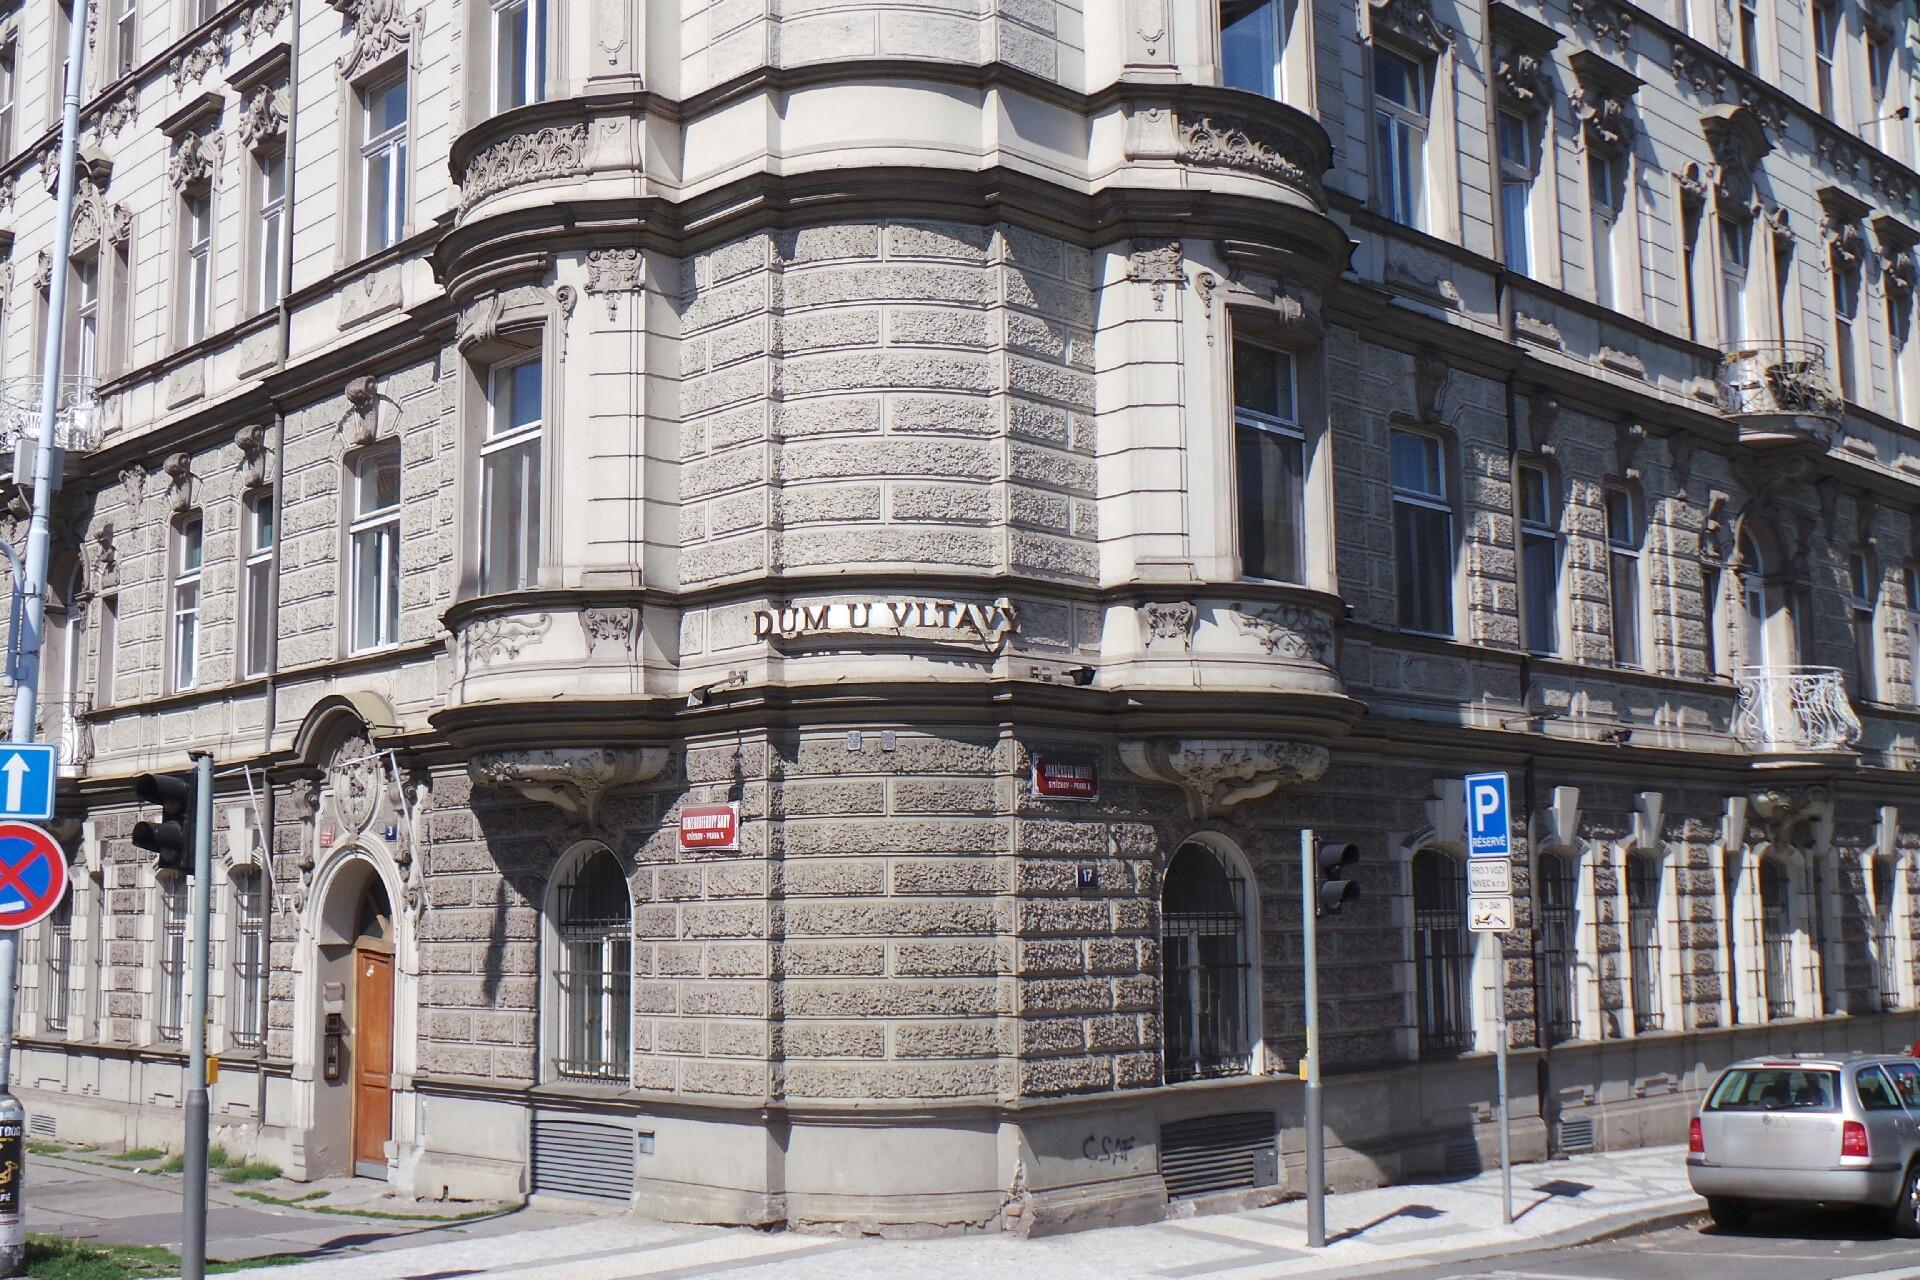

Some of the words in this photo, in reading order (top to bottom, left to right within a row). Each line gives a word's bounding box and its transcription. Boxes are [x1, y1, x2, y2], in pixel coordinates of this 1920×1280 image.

[847, 603, 872, 629] U
[887, 601, 1019, 633] VLTAVY
[1474, 785, 1499, 832] P
[387, 826, 393, 837] 3
[1472, 834, 1506, 848] RÉSERVÉ
[1083, 868, 1093, 883] 17
[4, 1126, 21, 1137] DOG
